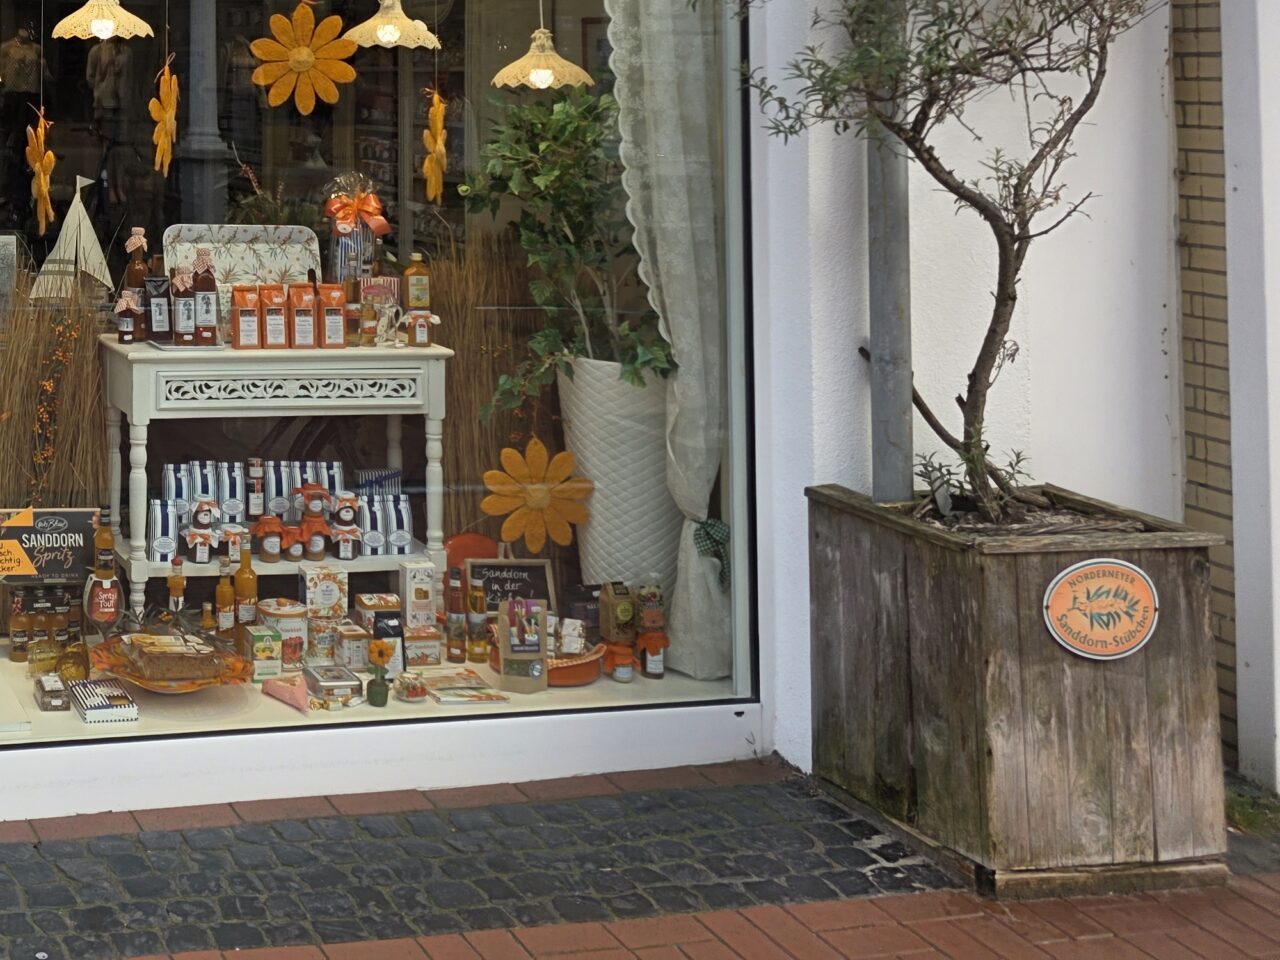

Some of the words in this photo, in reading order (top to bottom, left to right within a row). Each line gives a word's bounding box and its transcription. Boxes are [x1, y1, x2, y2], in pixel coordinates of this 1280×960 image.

[21, 532, 84, 548] SANDDORN
[32, 545, 75, 569] Spritz
[481, 567, 532, 583] Sanddorn
[1067, 569, 1137, 589] NORDERNEYER
[504, 580, 524, 591] der
[1056, 605, 1150, 649] Sanddorn-Stübchen
